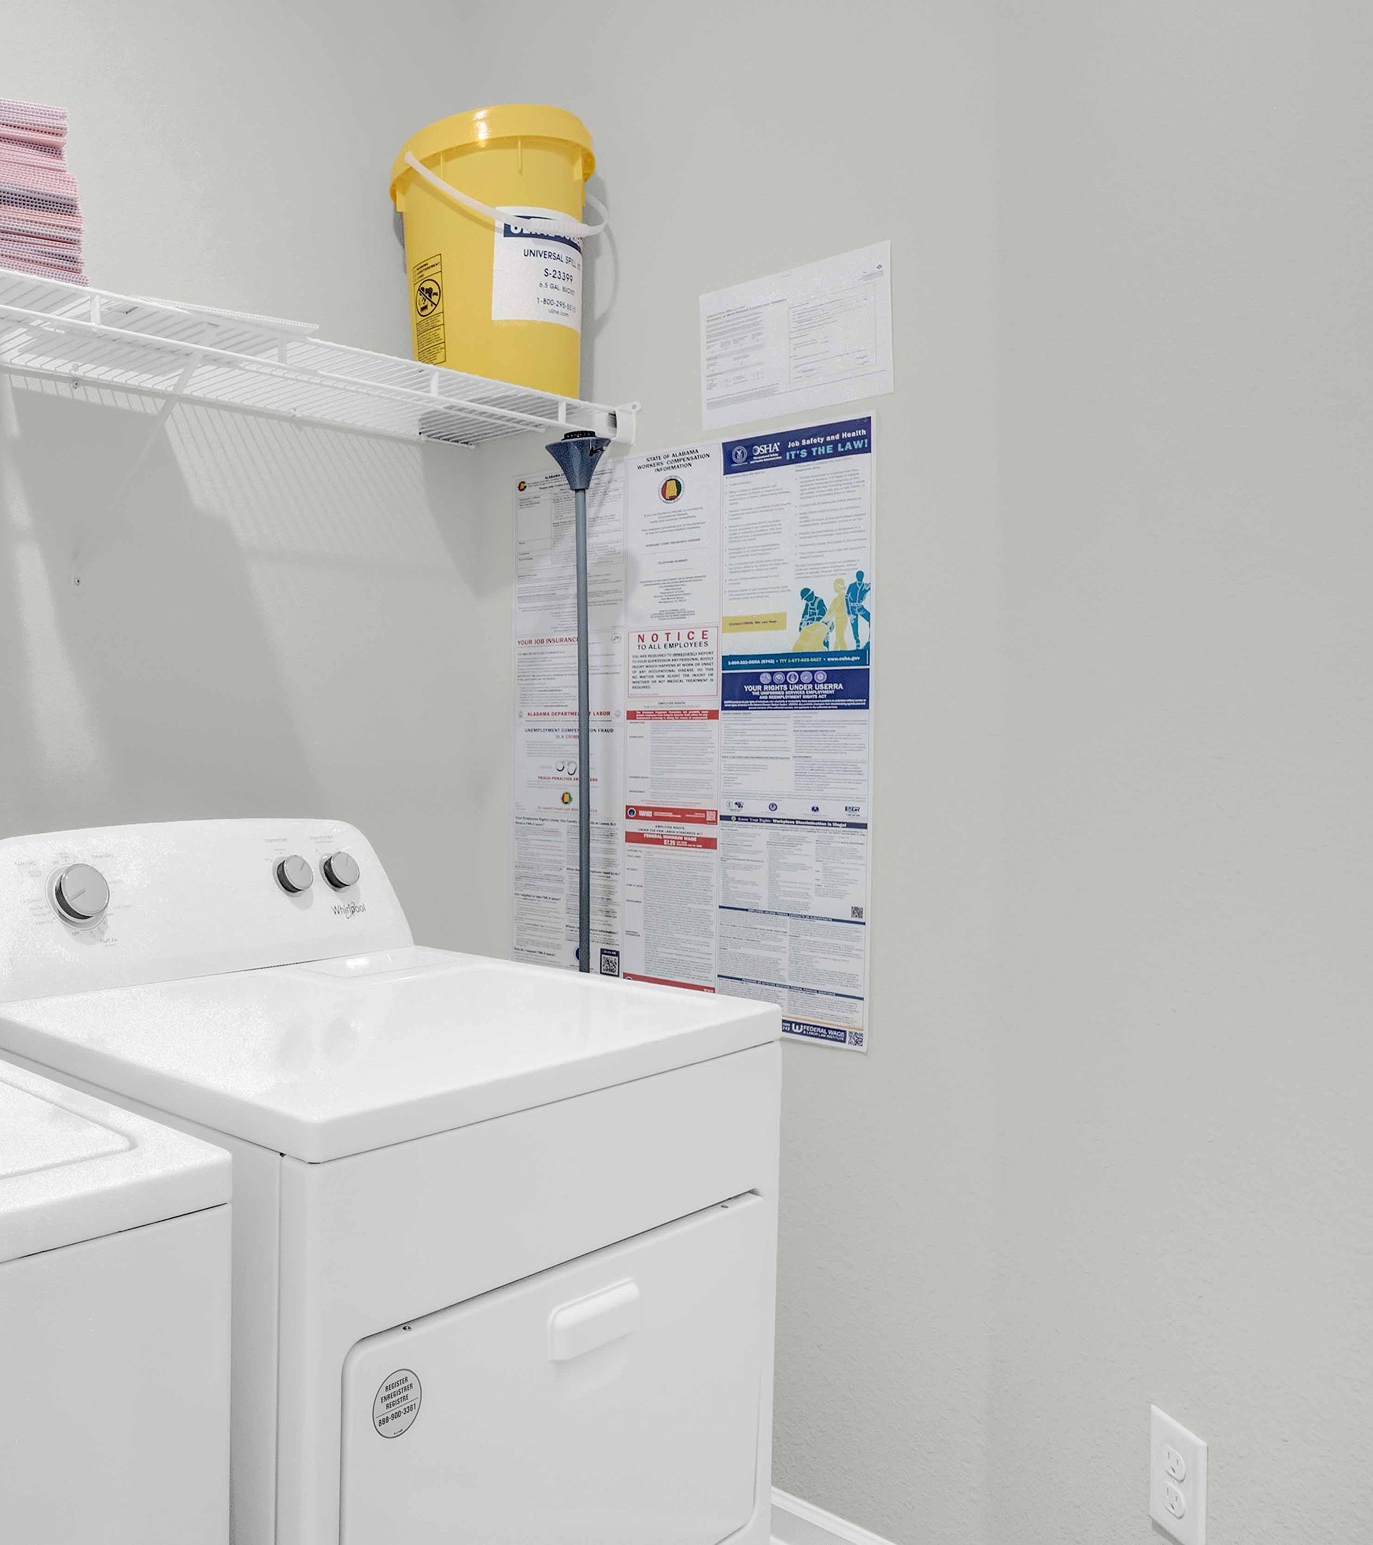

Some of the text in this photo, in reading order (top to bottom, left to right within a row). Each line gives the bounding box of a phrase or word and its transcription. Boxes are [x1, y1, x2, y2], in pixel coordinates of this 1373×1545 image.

[523, 249, 563, 263] UNIVERSAL
[543, 268, 574, 283] S-23399
[801, 436, 824, 444] Safety
[842, 429, 866, 439] Health
[671, 449, 699, 457] ALABAMA
[752, 443, 780, 455] OSHA
[786, 450, 808, 460] IT'S
[812, 445, 833, 454] THE
[837, 439, 868, 451] LAW!
[666, 453, 710, 465] COMPENSATION
[655, 463, 692, 472] INFORMATION
[638, 630, 708, 643] NOTICE
[664, 641, 708, 649] EMPLOYEES
[331, 902, 366, 919] Whirlpool
[803, 1025, 827, 1034] FEDERAL
[385, 1377, 408, 1392] REGISTER
[381, 1383, 413, 1403] ENREGISTRER
[386, 1394, 409, 1410] REGISTRE
